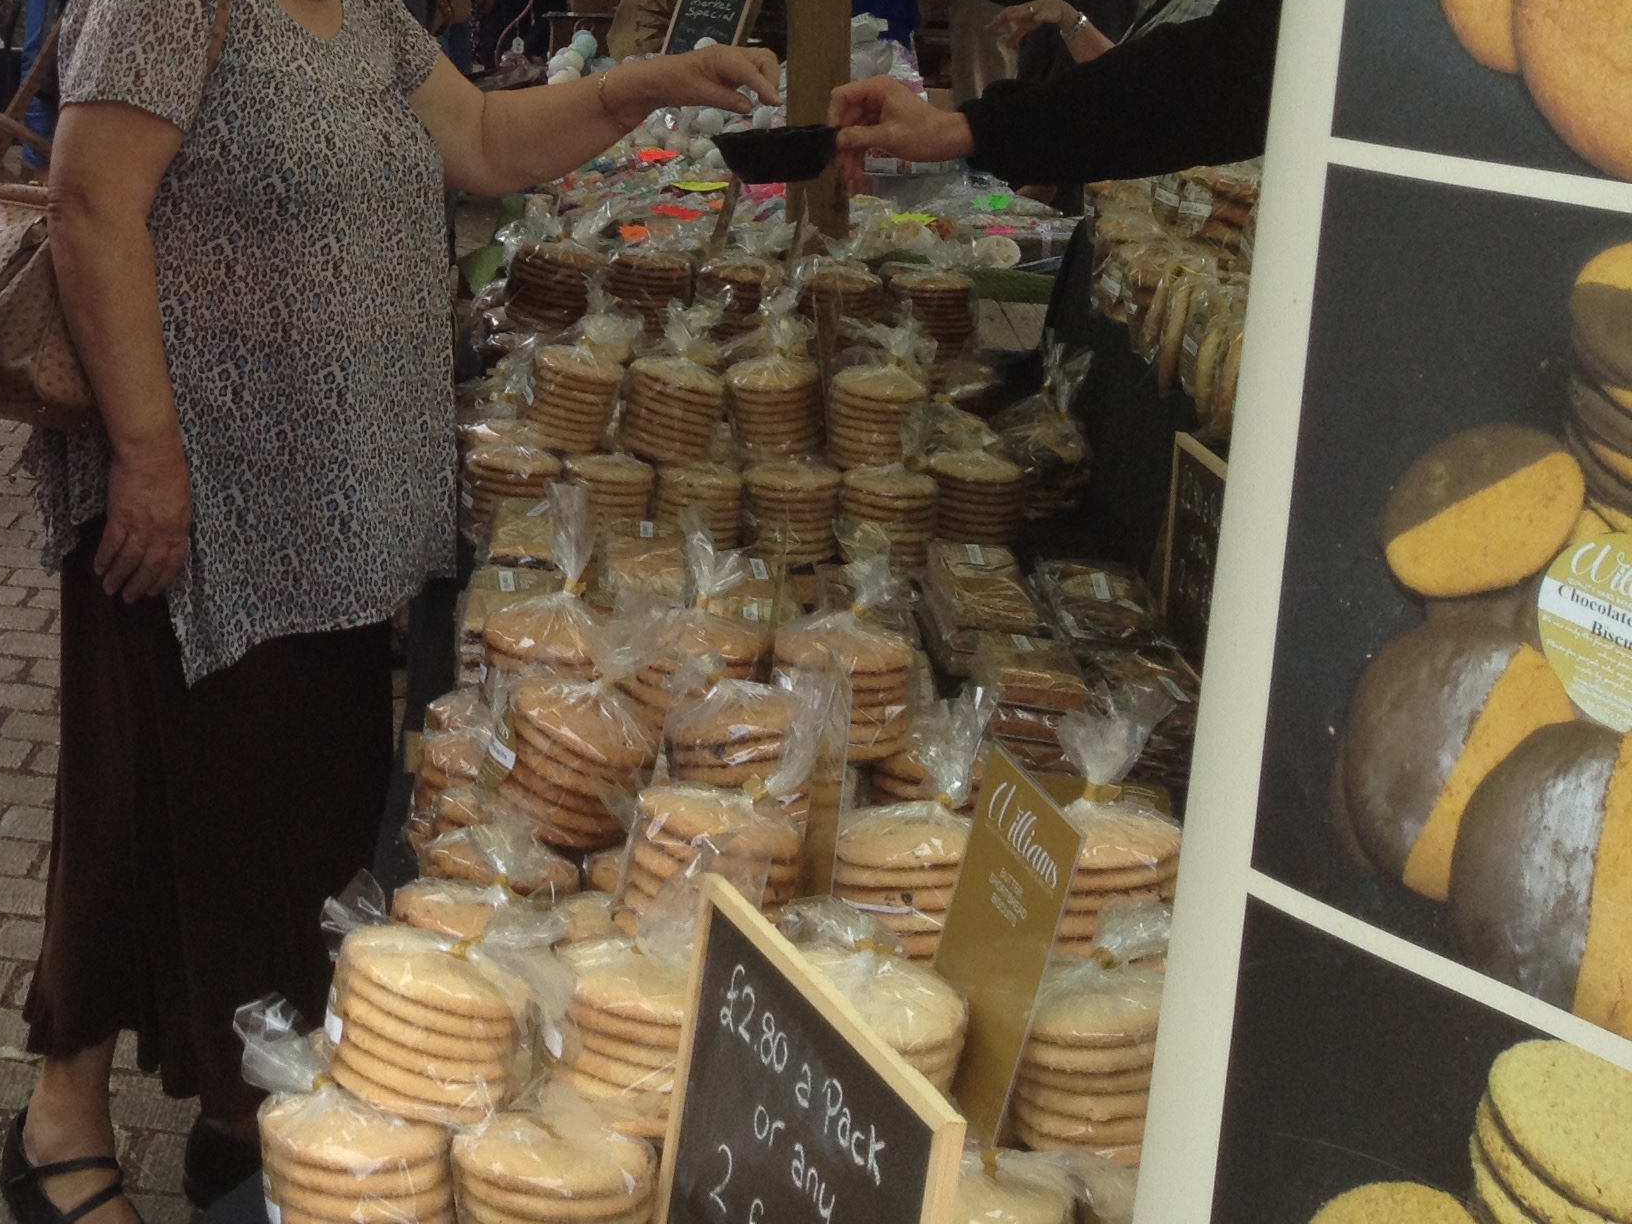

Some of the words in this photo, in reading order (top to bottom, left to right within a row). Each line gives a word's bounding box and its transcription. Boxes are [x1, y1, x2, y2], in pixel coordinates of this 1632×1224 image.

[1558, 584, 1632, 626] Chocolate
[988, 781, 1059, 890] Williams
[720, 963, 789, 1074] £2.80
[795, 1063, 812, 1109] a
[822, 1078, 886, 1187] Pack
[754, 1105, 785, 1147] or
[709, 1143, 732, 1214] 2
[791, 1142, 835, 1224] any
